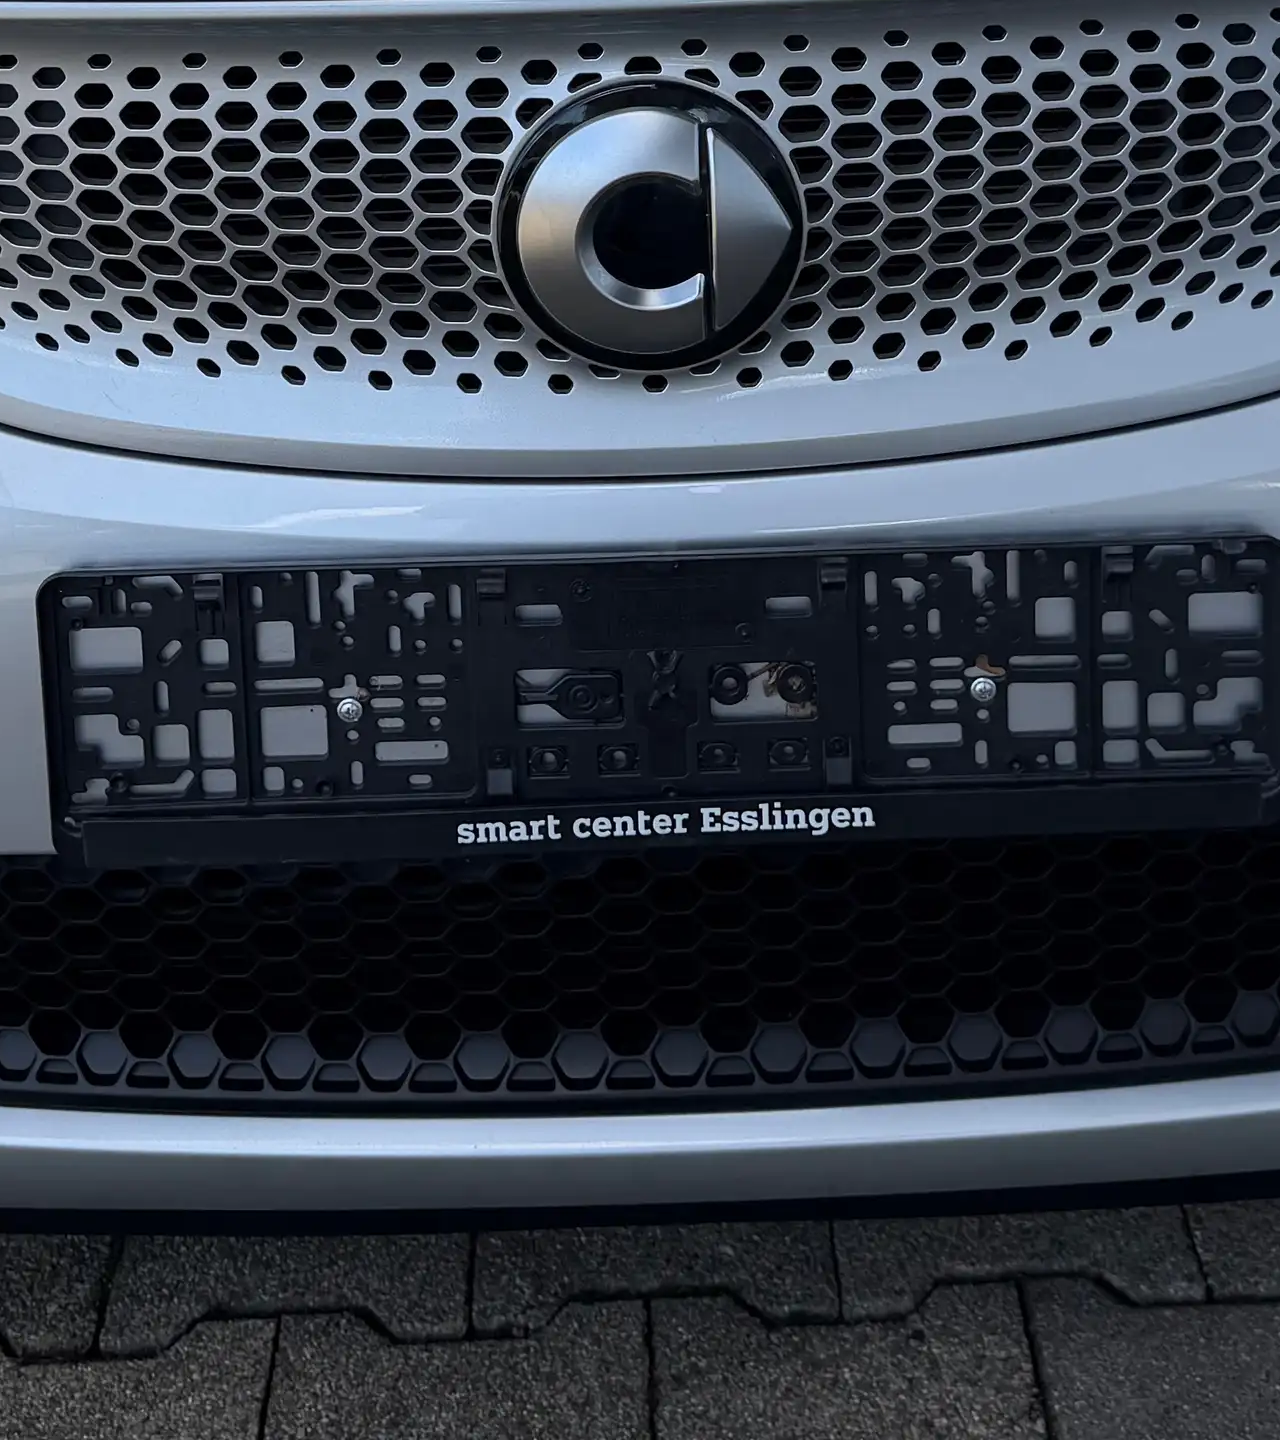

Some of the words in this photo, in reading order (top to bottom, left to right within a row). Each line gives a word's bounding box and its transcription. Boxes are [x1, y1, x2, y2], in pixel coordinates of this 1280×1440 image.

[457, 814, 562, 844] smart
[572, 810, 690, 839] center
[700, 802, 876, 836] Esslingen
